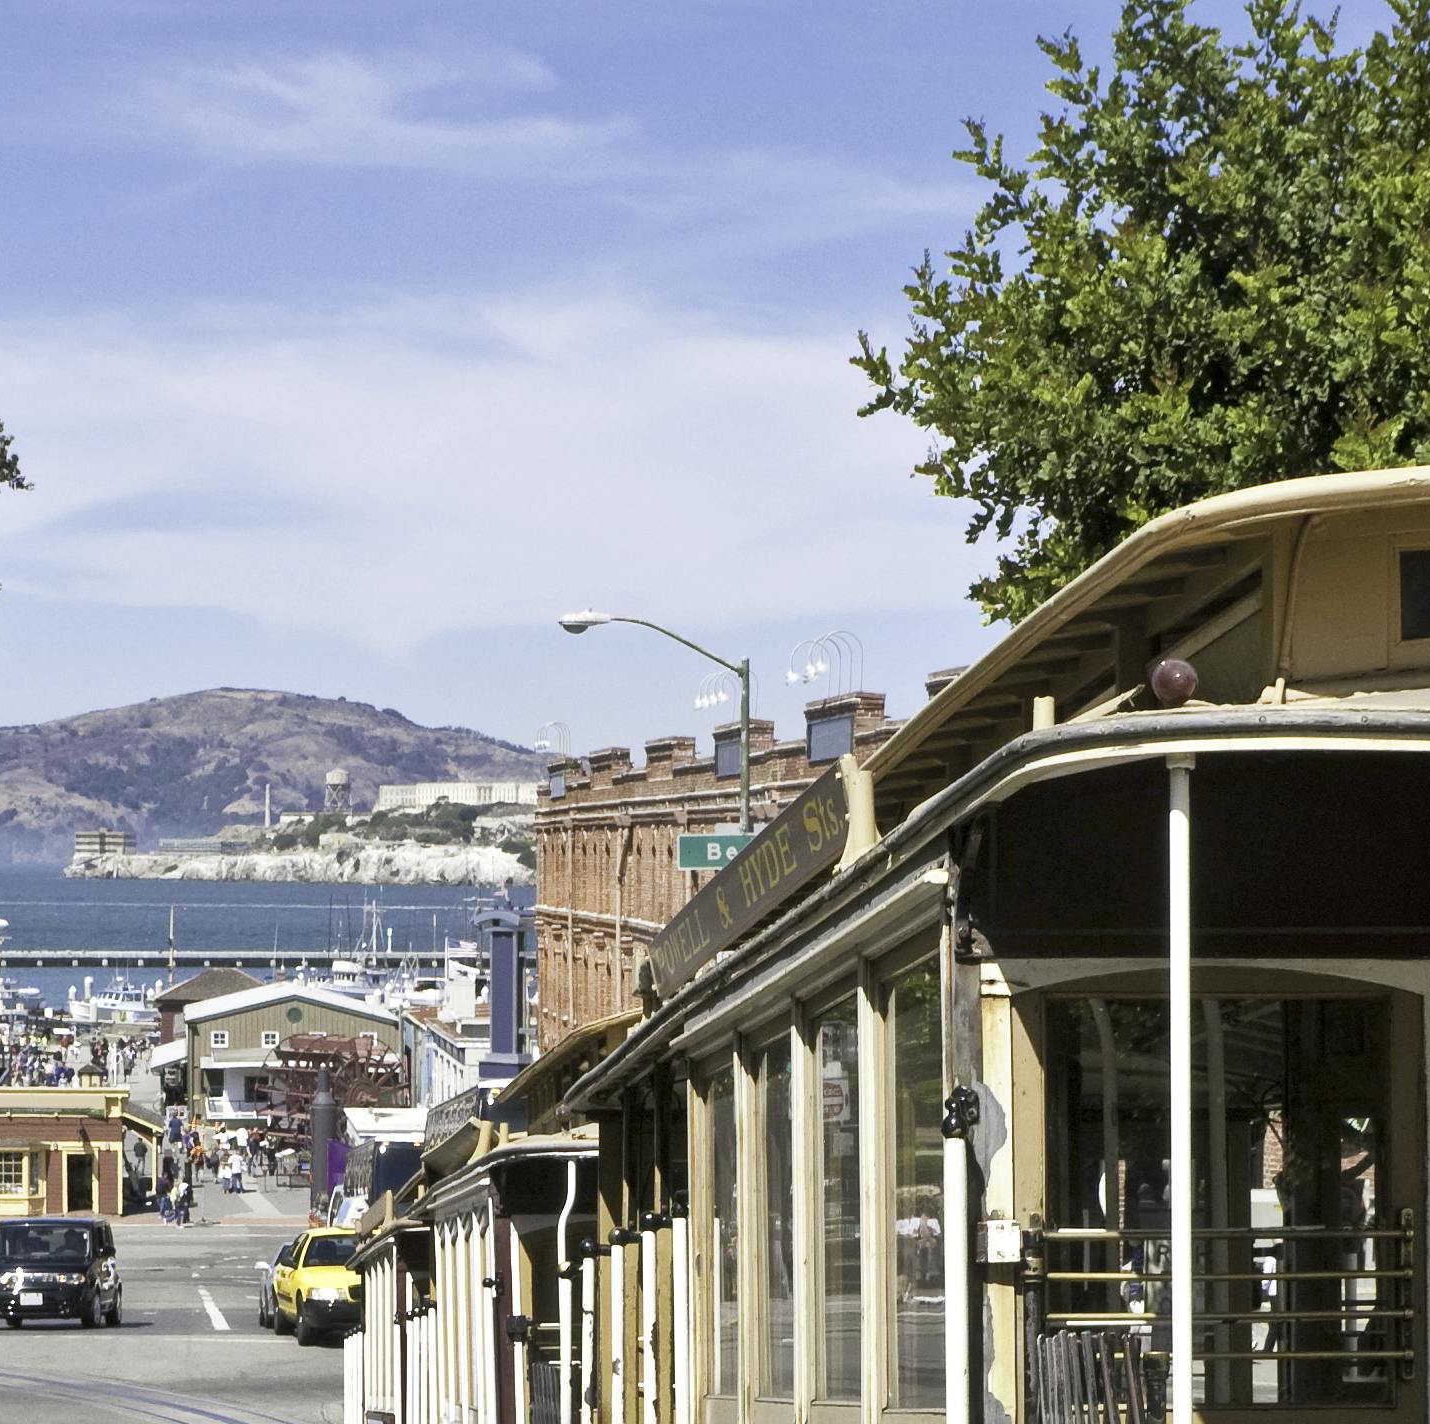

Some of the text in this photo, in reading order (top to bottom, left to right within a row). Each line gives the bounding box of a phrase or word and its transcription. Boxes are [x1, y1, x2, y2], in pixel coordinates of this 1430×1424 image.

[655, 797, 844, 982] POWELL & HYDE Sts.
